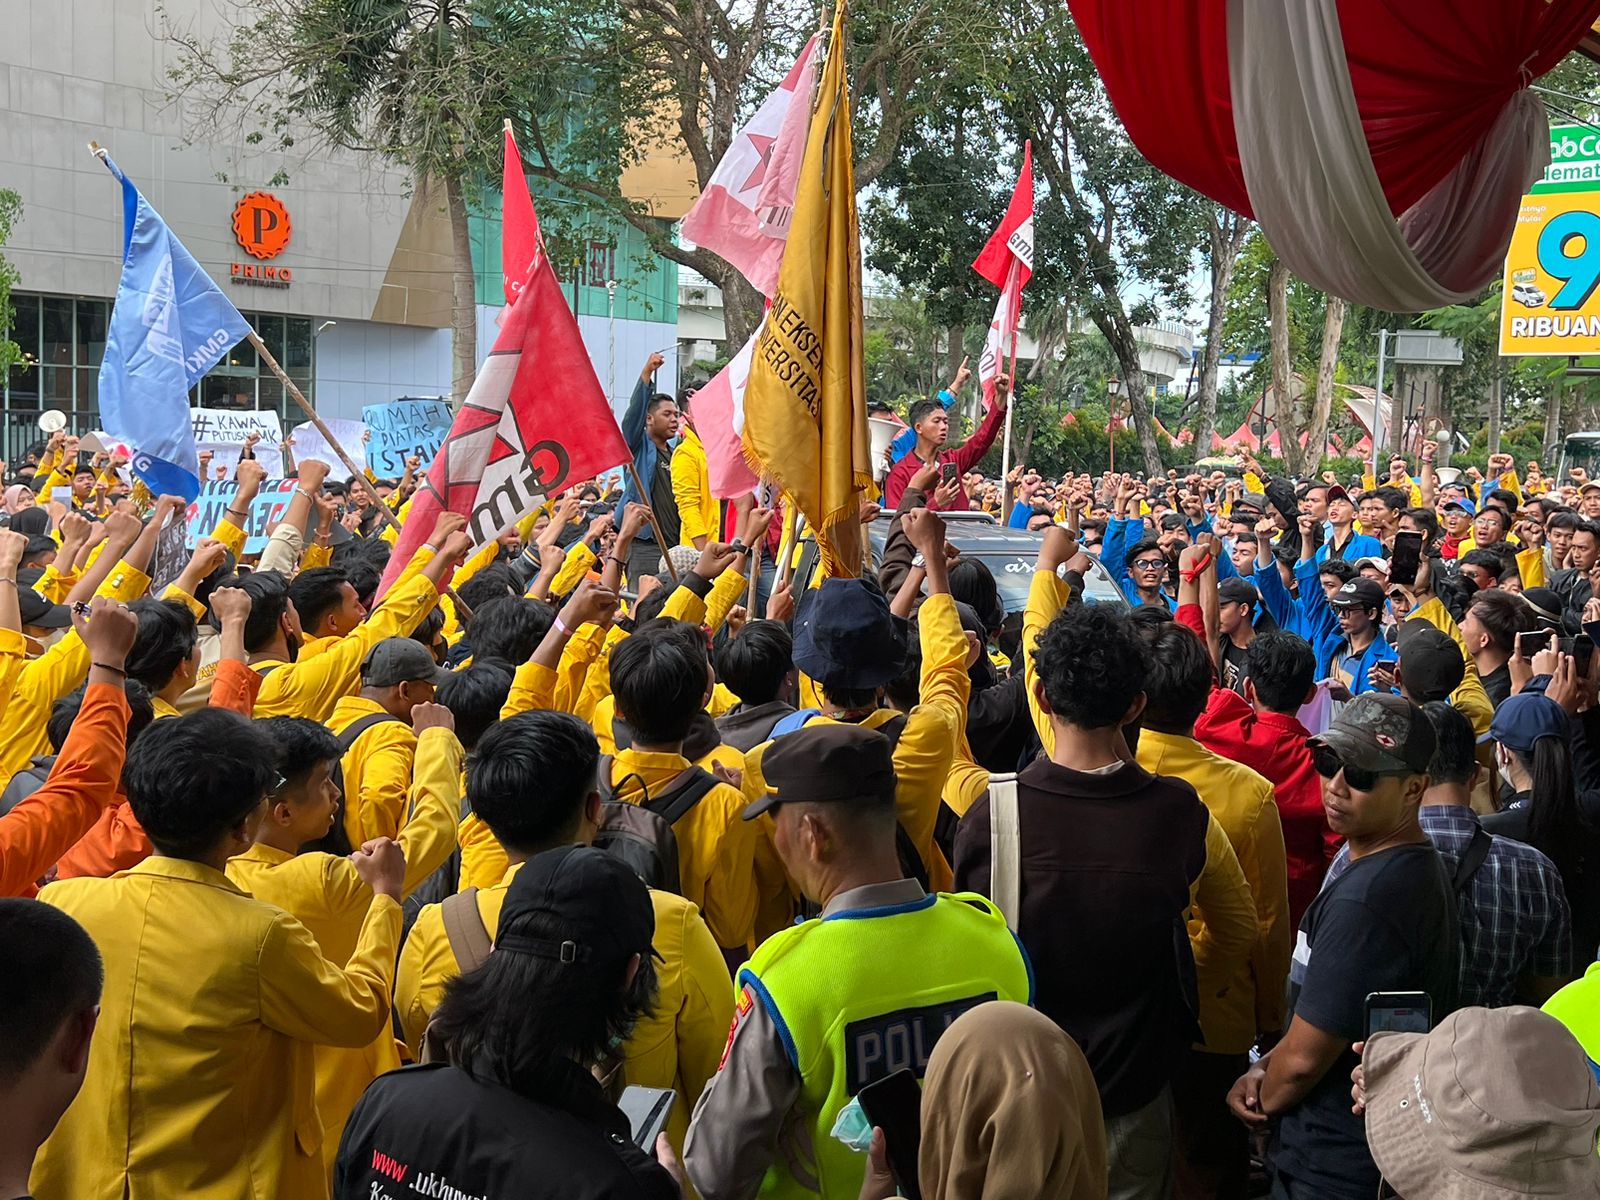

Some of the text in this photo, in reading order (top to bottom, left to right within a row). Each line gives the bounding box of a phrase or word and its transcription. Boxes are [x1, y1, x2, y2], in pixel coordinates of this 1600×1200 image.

[252, 207, 278, 244] P
[231, 263, 292, 281] PRIMO
[217, 415, 267, 430] KAWAL
[365, 404, 440, 431] RUMAH
[381, 424, 434, 446] DIATAS
